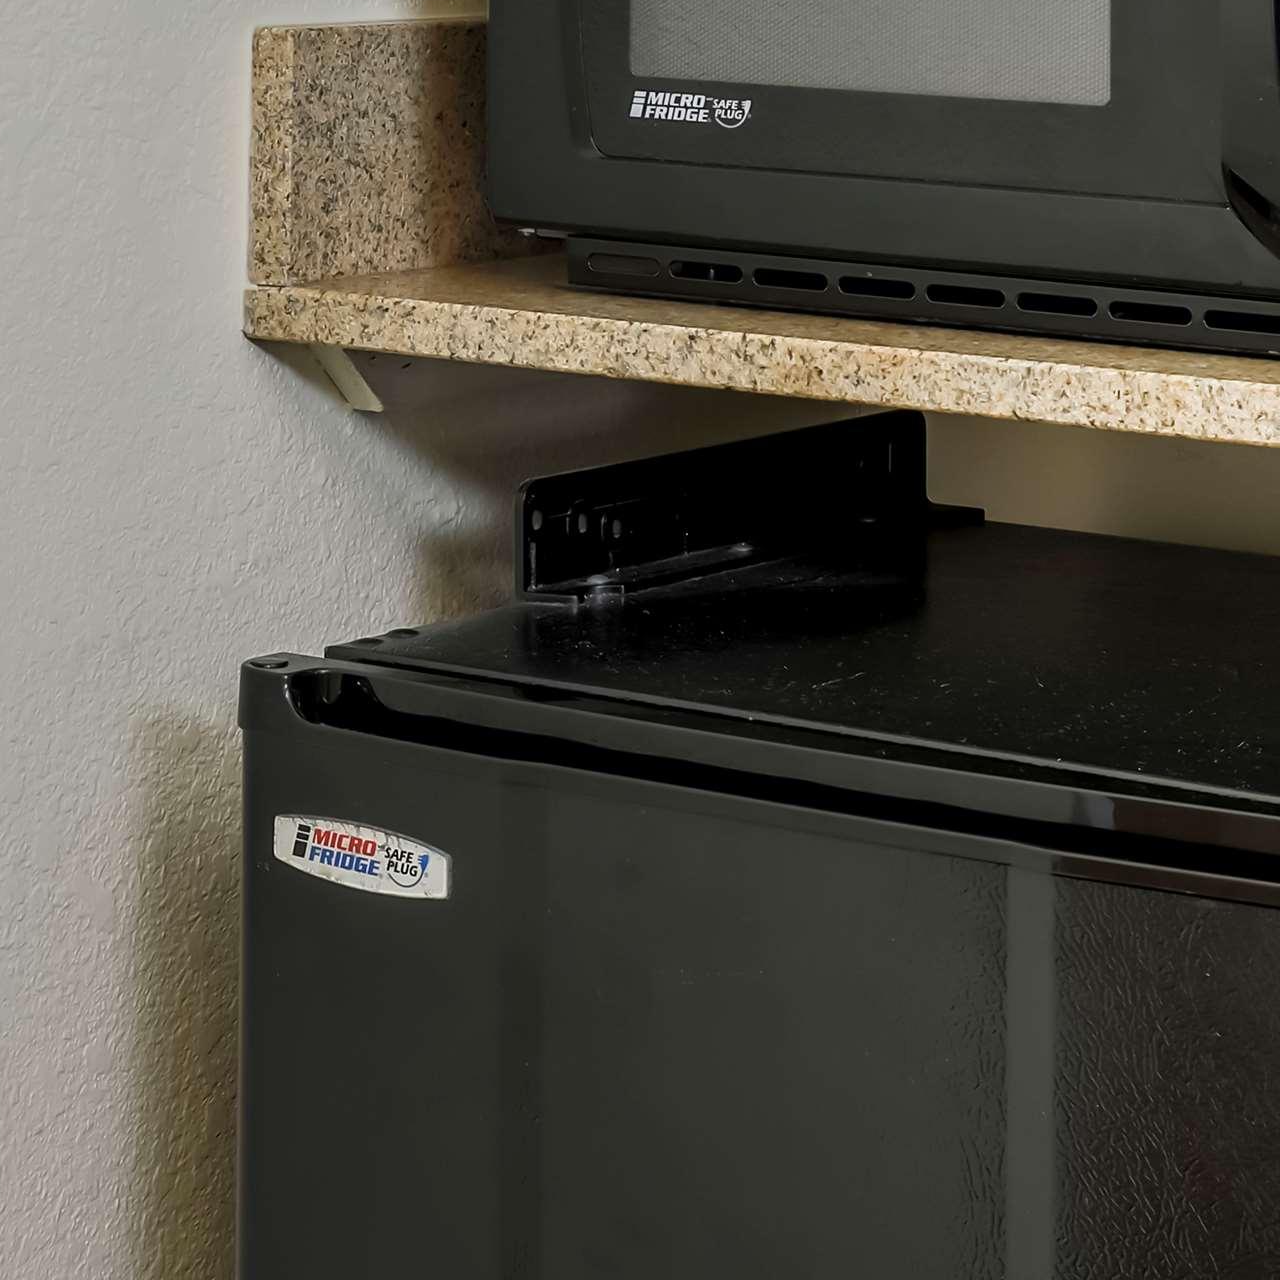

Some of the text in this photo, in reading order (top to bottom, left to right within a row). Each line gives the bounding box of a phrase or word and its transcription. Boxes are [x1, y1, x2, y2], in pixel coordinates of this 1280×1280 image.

[712, 99, 739, 110] SAFE
[644, 105, 710, 123] FRIDGE
[715, 108, 743, 120] PLUG
[308, 845, 381, 876] FRIDGE
[384, 847, 414, 864] SAFE
[386, 860, 418, 877] PLUG
